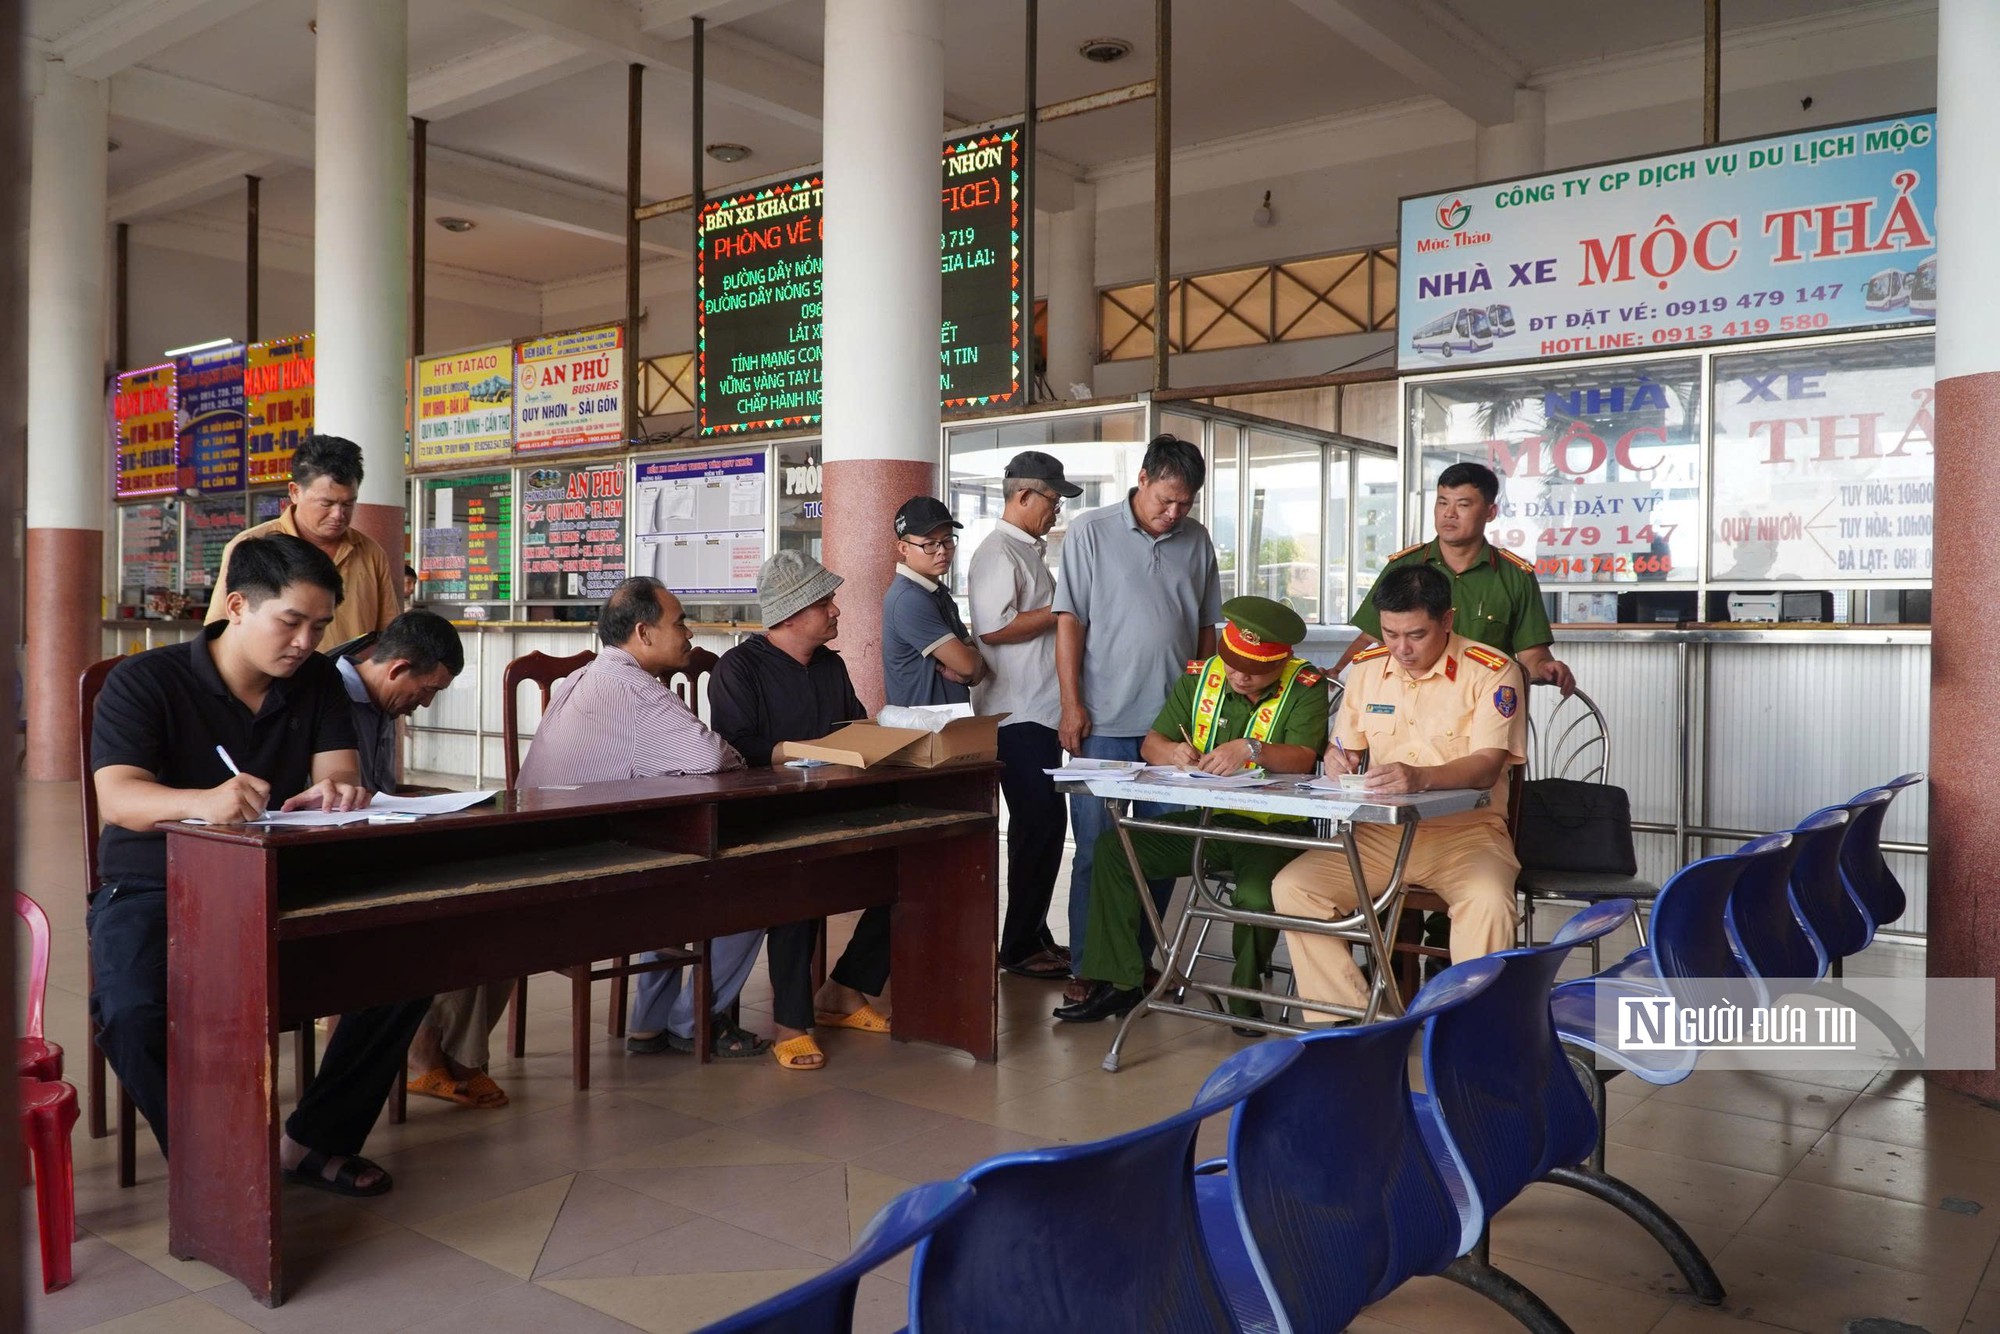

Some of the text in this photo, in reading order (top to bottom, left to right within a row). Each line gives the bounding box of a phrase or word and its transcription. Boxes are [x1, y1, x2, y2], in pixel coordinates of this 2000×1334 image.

[1495, 123, 1929, 209] CÔNG TY CP DỊCH VỤ DU LỊCH MỘC
[705, 146, 1003, 231] BẾN XE KHÁCH NHƠN
[715, 228, 782, 260] PHÒNG
[786, 215, 812, 244] VÉ
[1418, 173, 1931, 300] NHÀ XE MỘC THẢ
[1454, 231, 1492, 247] Thảo
[723, 227, 975, 290] ĐƯỜNG DÂY NÓN 719
[705, 292, 747, 314] ĐƯỜNG
[749, 286, 773, 307] DÂY
[775, 280, 810, 302] NÓNG
[1529, 284, 1844, 332] ĐT ĐẶT VÉ: 0919 479 147
[789, 322, 809, 343] LÁI
[1540, 312, 1829, 355] HOTLINE: 0913 419 580
[434, 355, 497, 377] HTX TATACO
[541, 352, 610, 386] AN PHÚ
[731, 353, 758, 373] TÍNH
[761, 350, 795, 370] MẠNG
[954, 347, 978, 365] TIN
[572, 380, 619, 395] BUSLINES
[720, 369, 811, 395] VỮNG VÀNG TAY
[1545, 370, 1828, 418] NHÀ XE
[522, 407, 539, 423] QUY
[542, 403, 567, 419] NHƠN
[579, 398, 594, 415] SÀI
[598, 395, 617, 413] GÒN
[737, 393, 768, 414] CHẤP
[770, 390, 804, 410] HÀNH
[1483, 388, 1935, 485] MỘC THẢ
[566, 462, 625, 498] AN PHÚ
[786, 456, 822, 495] PHÒ
[1574, 496, 1624, 518] ĐẶT
[1841, 484, 1862, 507] TUY
[1867, 479, 1893, 506] HÒA:
[546, 503, 562, 523] QUY
[562, 501, 585, 520] NHƠN
[590, 501, 602, 518] TP.
[603, 500, 623, 517] HCM
[804, 501, 822, 519] TIC
[1490, 523, 1679, 548] 19 479 147
[1721, 512, 1802, 545] QUY NHƠN
[1840, 517, 1862, 539] TUY
[1866, 511, 1892, 538] HÒA:
[1535, 555, 1674, 576] 0914 742 668
[1838, 545, 1857, 570] ĐÀ
[1860, 549, 1889, 573] LẠT:
